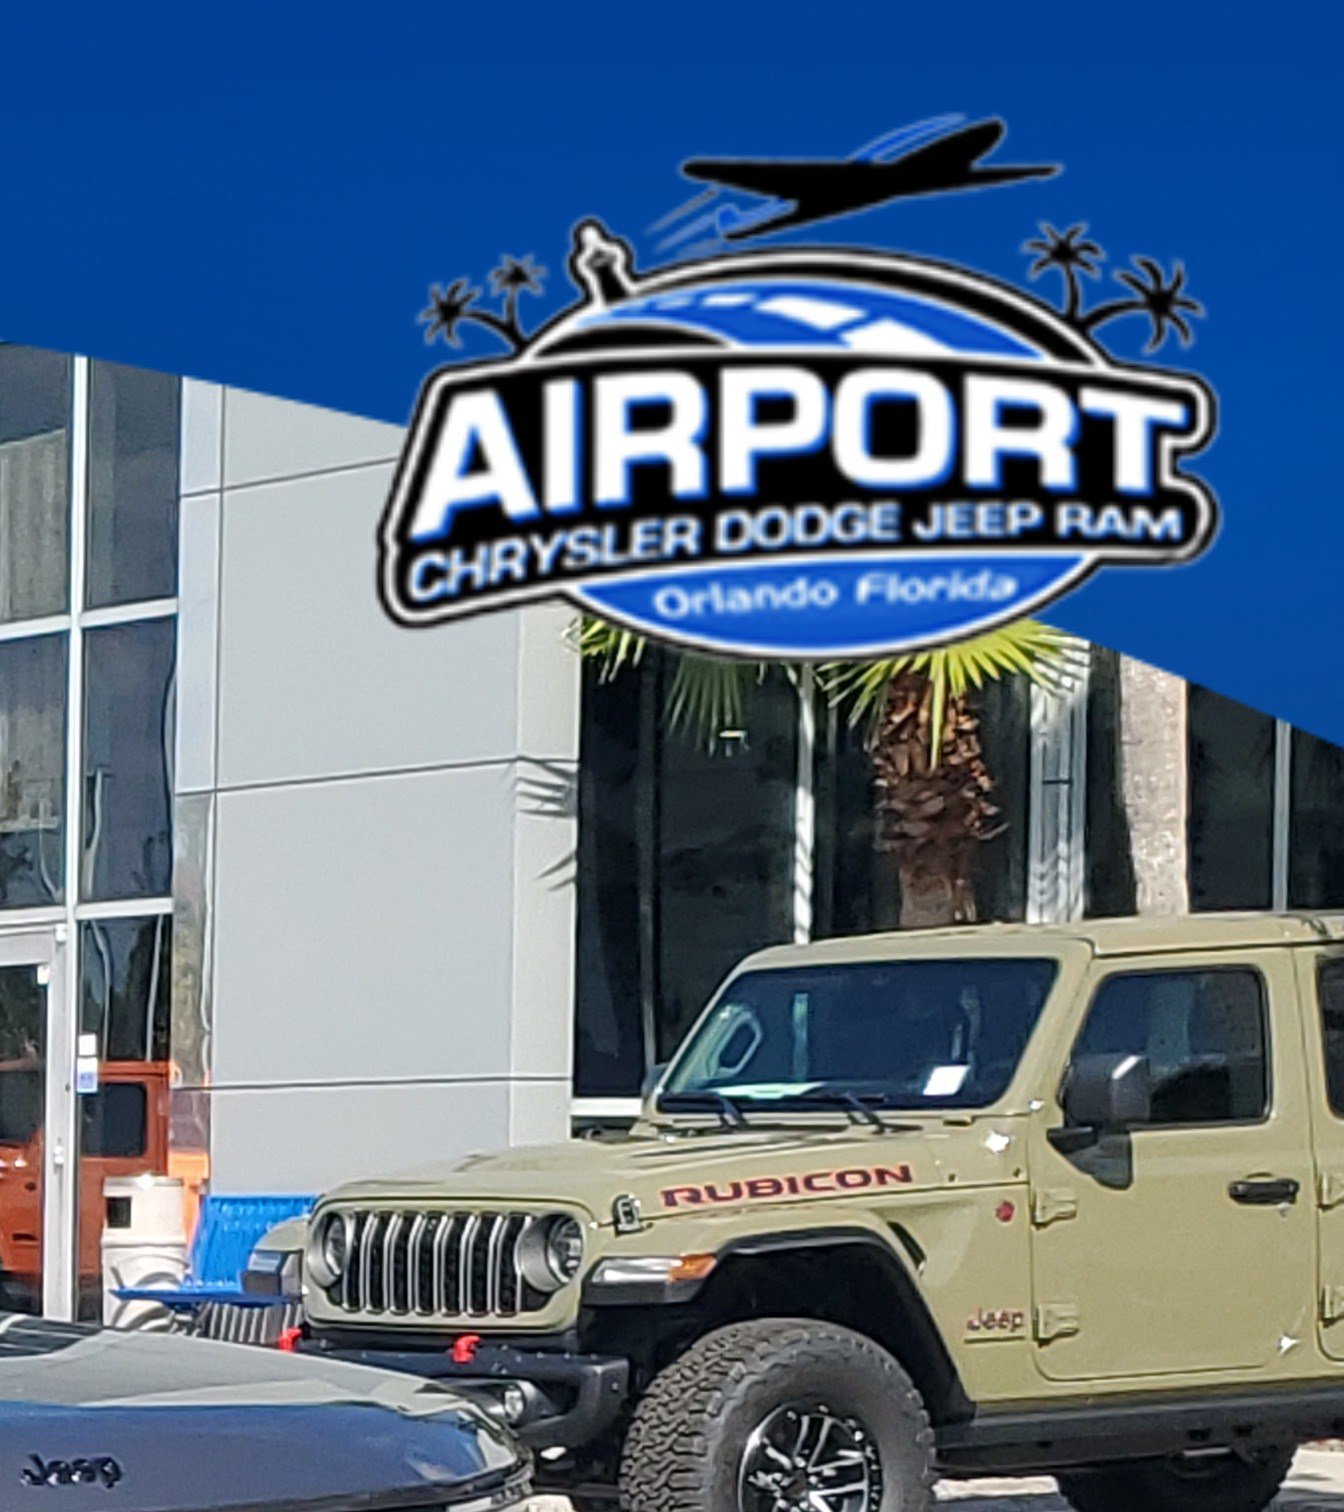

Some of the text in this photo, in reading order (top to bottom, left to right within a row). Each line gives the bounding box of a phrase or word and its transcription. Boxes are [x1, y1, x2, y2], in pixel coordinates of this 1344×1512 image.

[661, 1164, 912, 1207] RUBICON
[966, 1306, 1025, 1333] Jeep
[20, 1452, 123, 1490] Jeep
